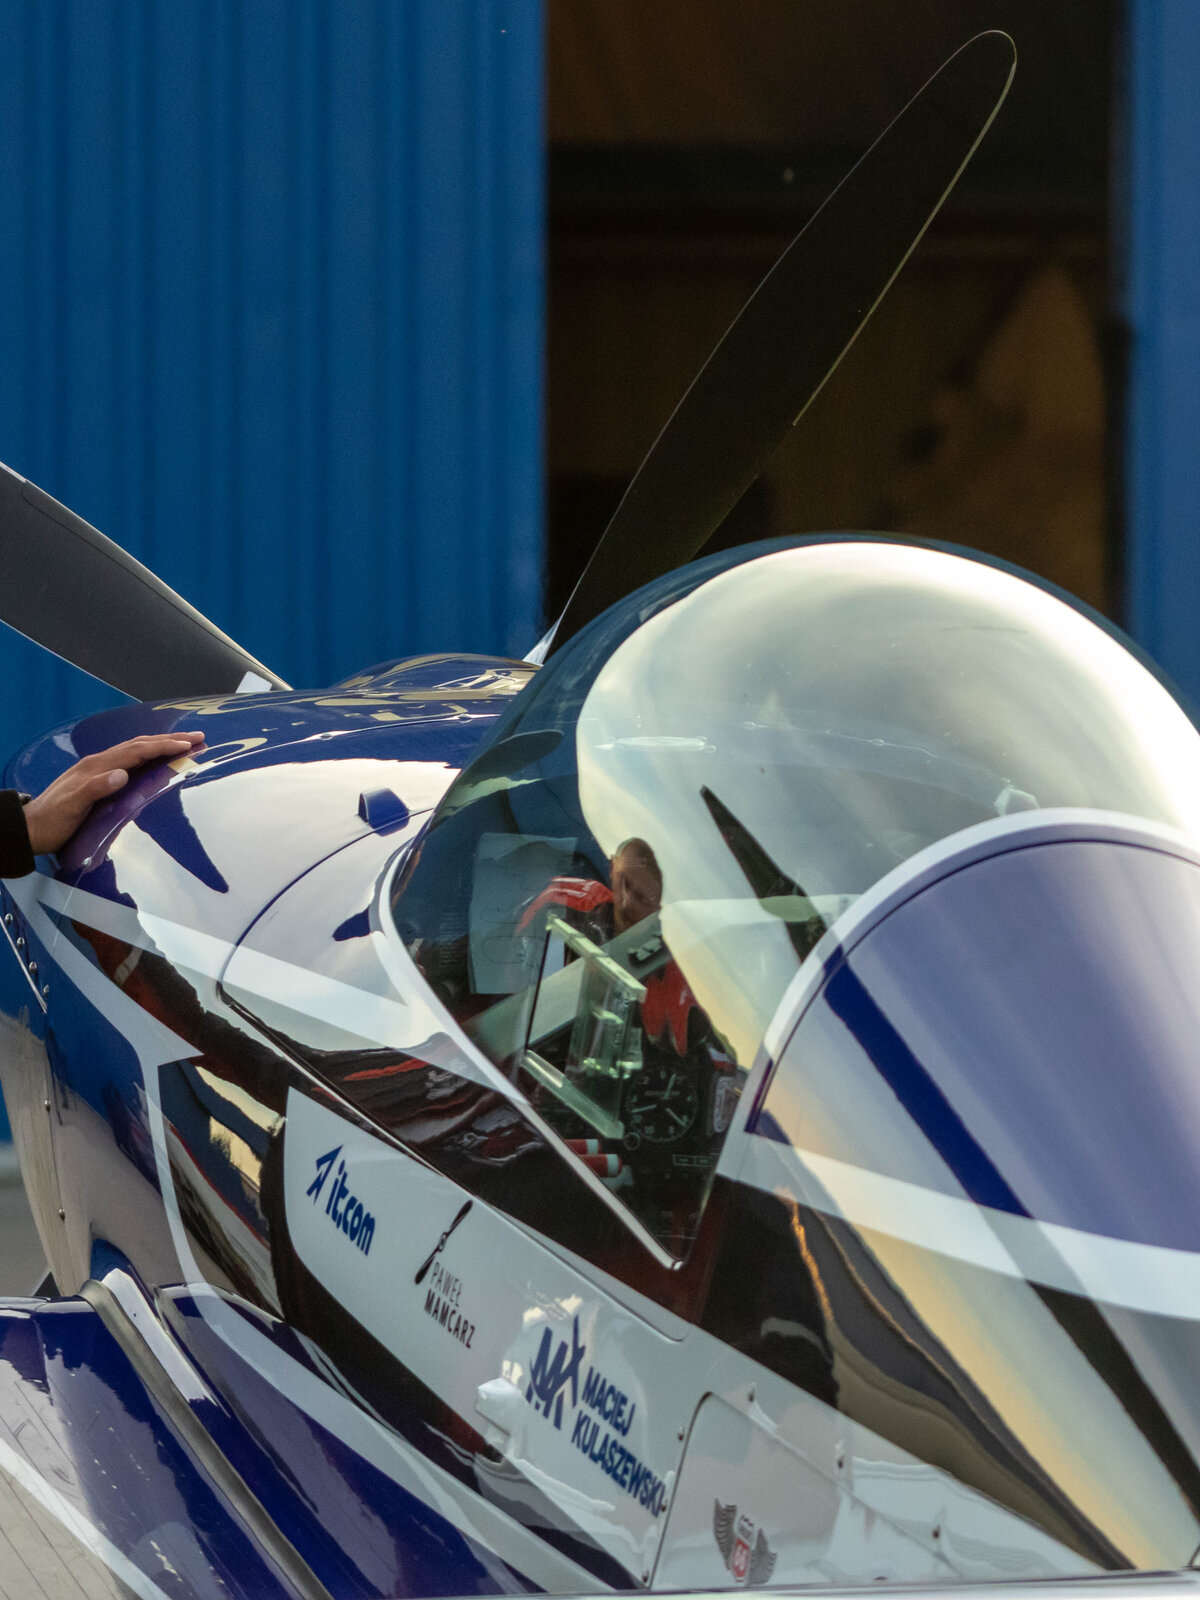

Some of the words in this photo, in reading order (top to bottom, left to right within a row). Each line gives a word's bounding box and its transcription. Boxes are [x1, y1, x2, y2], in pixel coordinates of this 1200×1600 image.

[430, 1261, 463, 1308] PAWEŁ
[423, 1288, 476, 1350] MAMCARZ
[581, 1366, 636, 1438] MACIEJ
[571, 1409, 666, 1519] KULASZEWSKI
